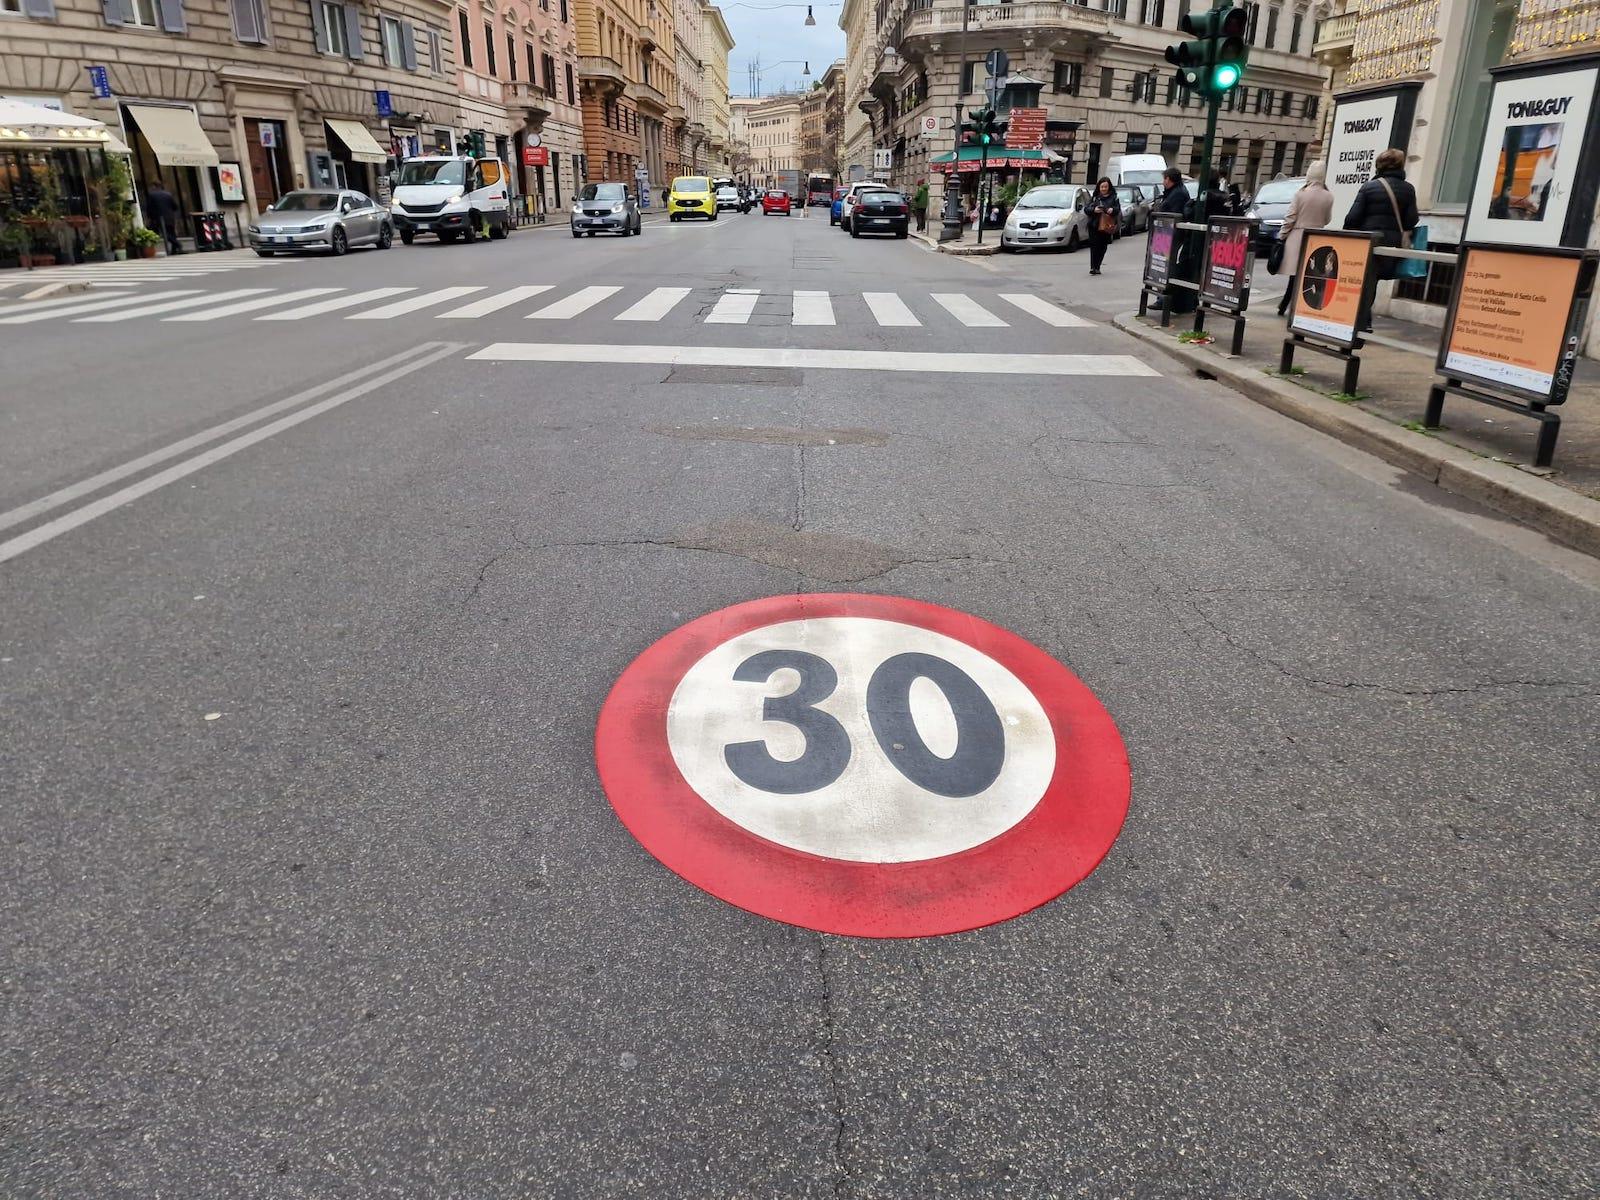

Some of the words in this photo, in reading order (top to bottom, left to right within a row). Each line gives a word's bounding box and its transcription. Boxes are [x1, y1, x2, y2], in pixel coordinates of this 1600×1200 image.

[1507, 96, 1574, 119] TONI&GUY
[1343, 117, 1383, 134] TONI&GUY
[1339, 149, 1375, 162] EXCLUSIVE
[1355, 161, 1372, 172] HAIR
[1335, 173, 1370, 184] MAKEOVER
[724, 649, 1005, 798] 30
